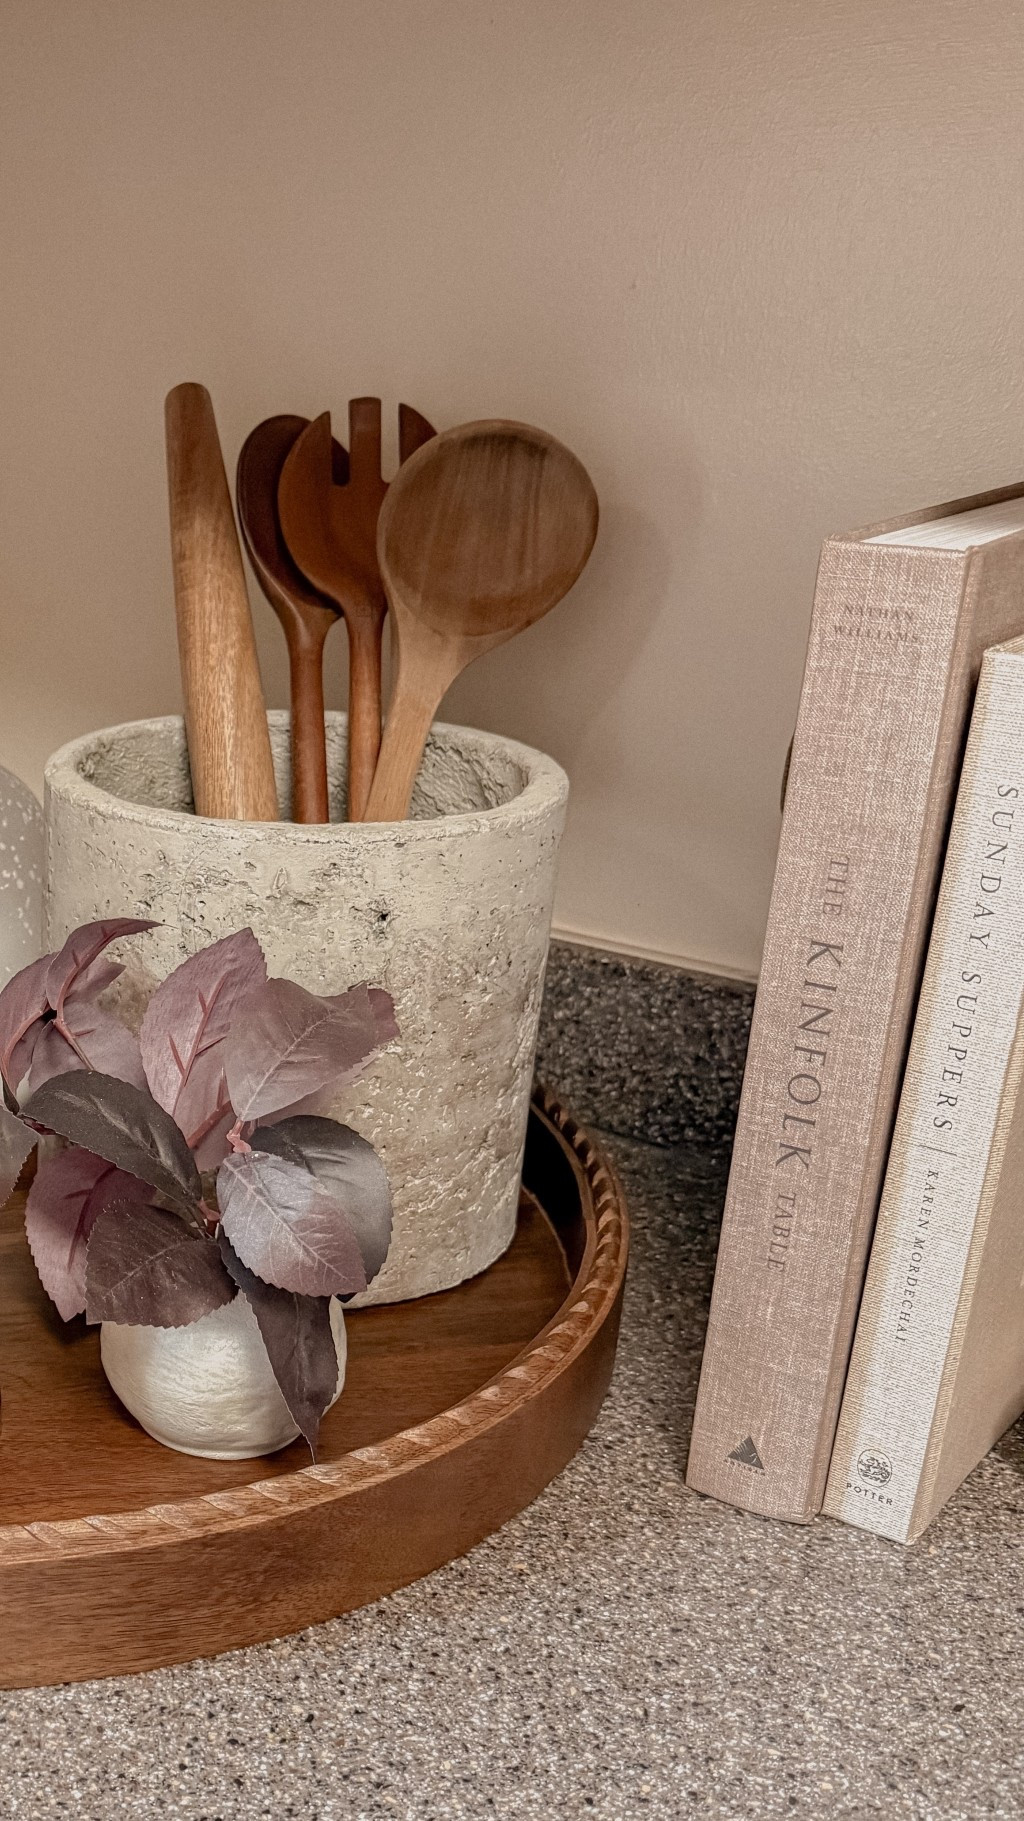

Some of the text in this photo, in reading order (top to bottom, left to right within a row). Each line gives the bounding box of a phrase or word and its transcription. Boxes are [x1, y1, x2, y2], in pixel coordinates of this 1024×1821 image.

[766, 856, 850, 1274] THE KINFOLK TABLE
[896, 783, 1019, 1343] SUNDAY SUPPERS KAREN MORDECHAI
[846, 1482, 893, 1506] POTTER
